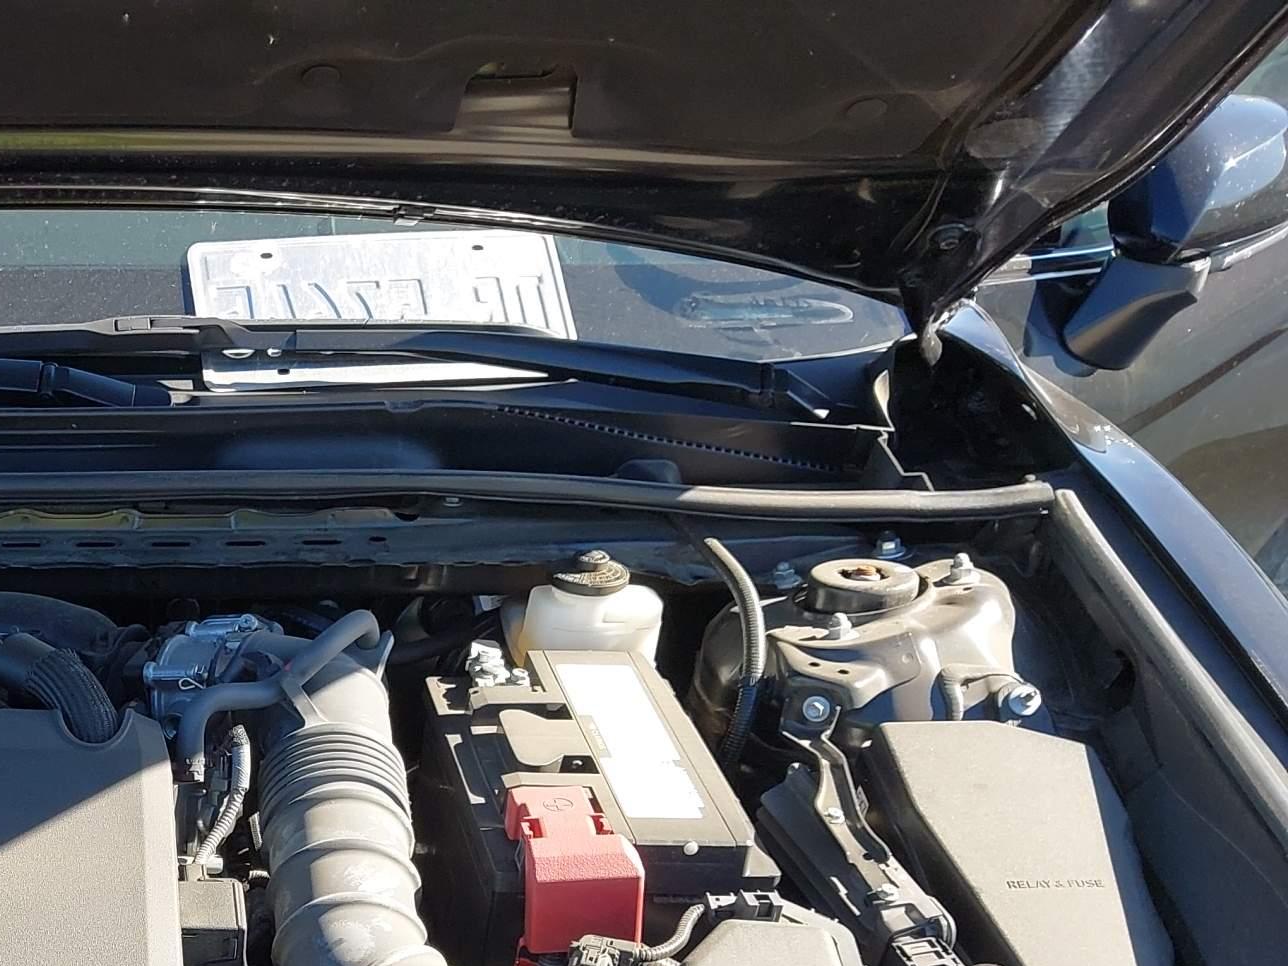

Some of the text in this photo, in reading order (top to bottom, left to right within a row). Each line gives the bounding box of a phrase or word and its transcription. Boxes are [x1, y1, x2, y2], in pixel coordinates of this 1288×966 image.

[1006, 879, 1105, 889] RELAY & FUSE
